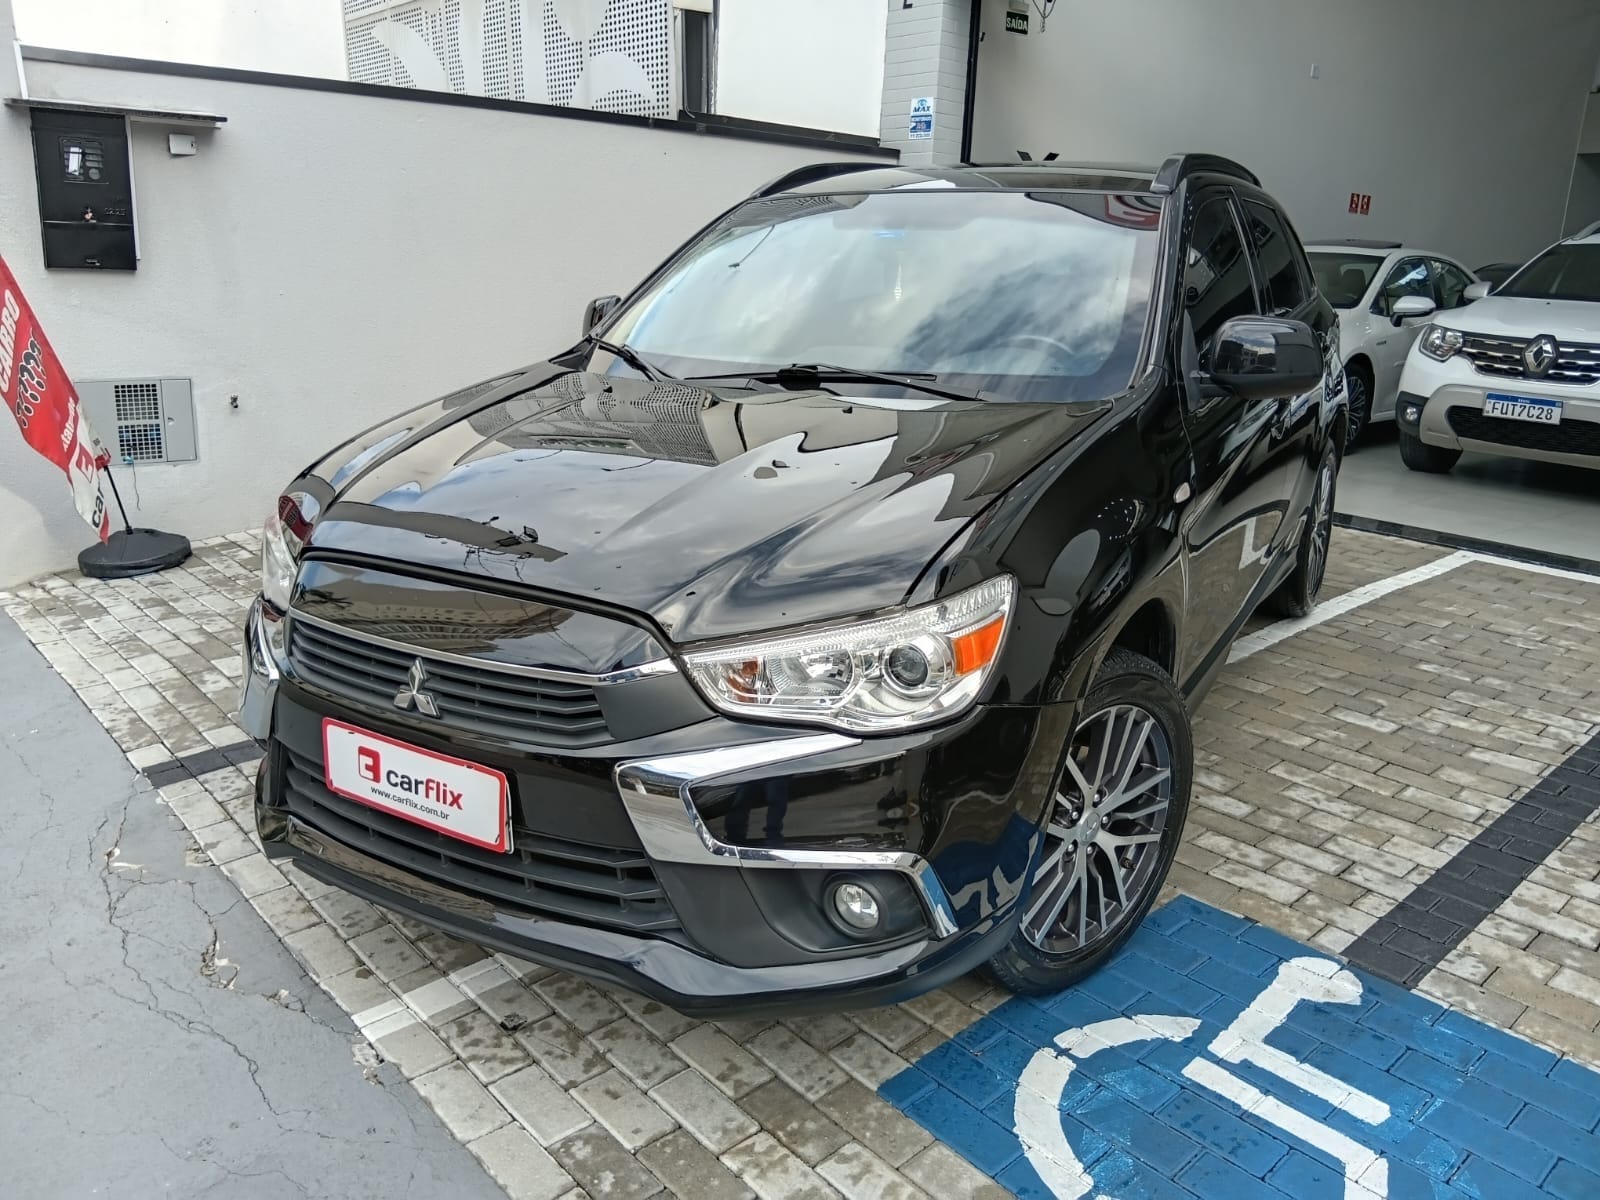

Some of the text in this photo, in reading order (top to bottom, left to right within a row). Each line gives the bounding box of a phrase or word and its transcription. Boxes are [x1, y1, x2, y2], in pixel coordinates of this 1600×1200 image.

[1006, 16, 1028, 31] SAÍDA
[1491, 401, 1554, 421] FUT7C28
[370, 786, 450, 821] www.carflix.com.br
[386, 769, 464, 811] carflix
